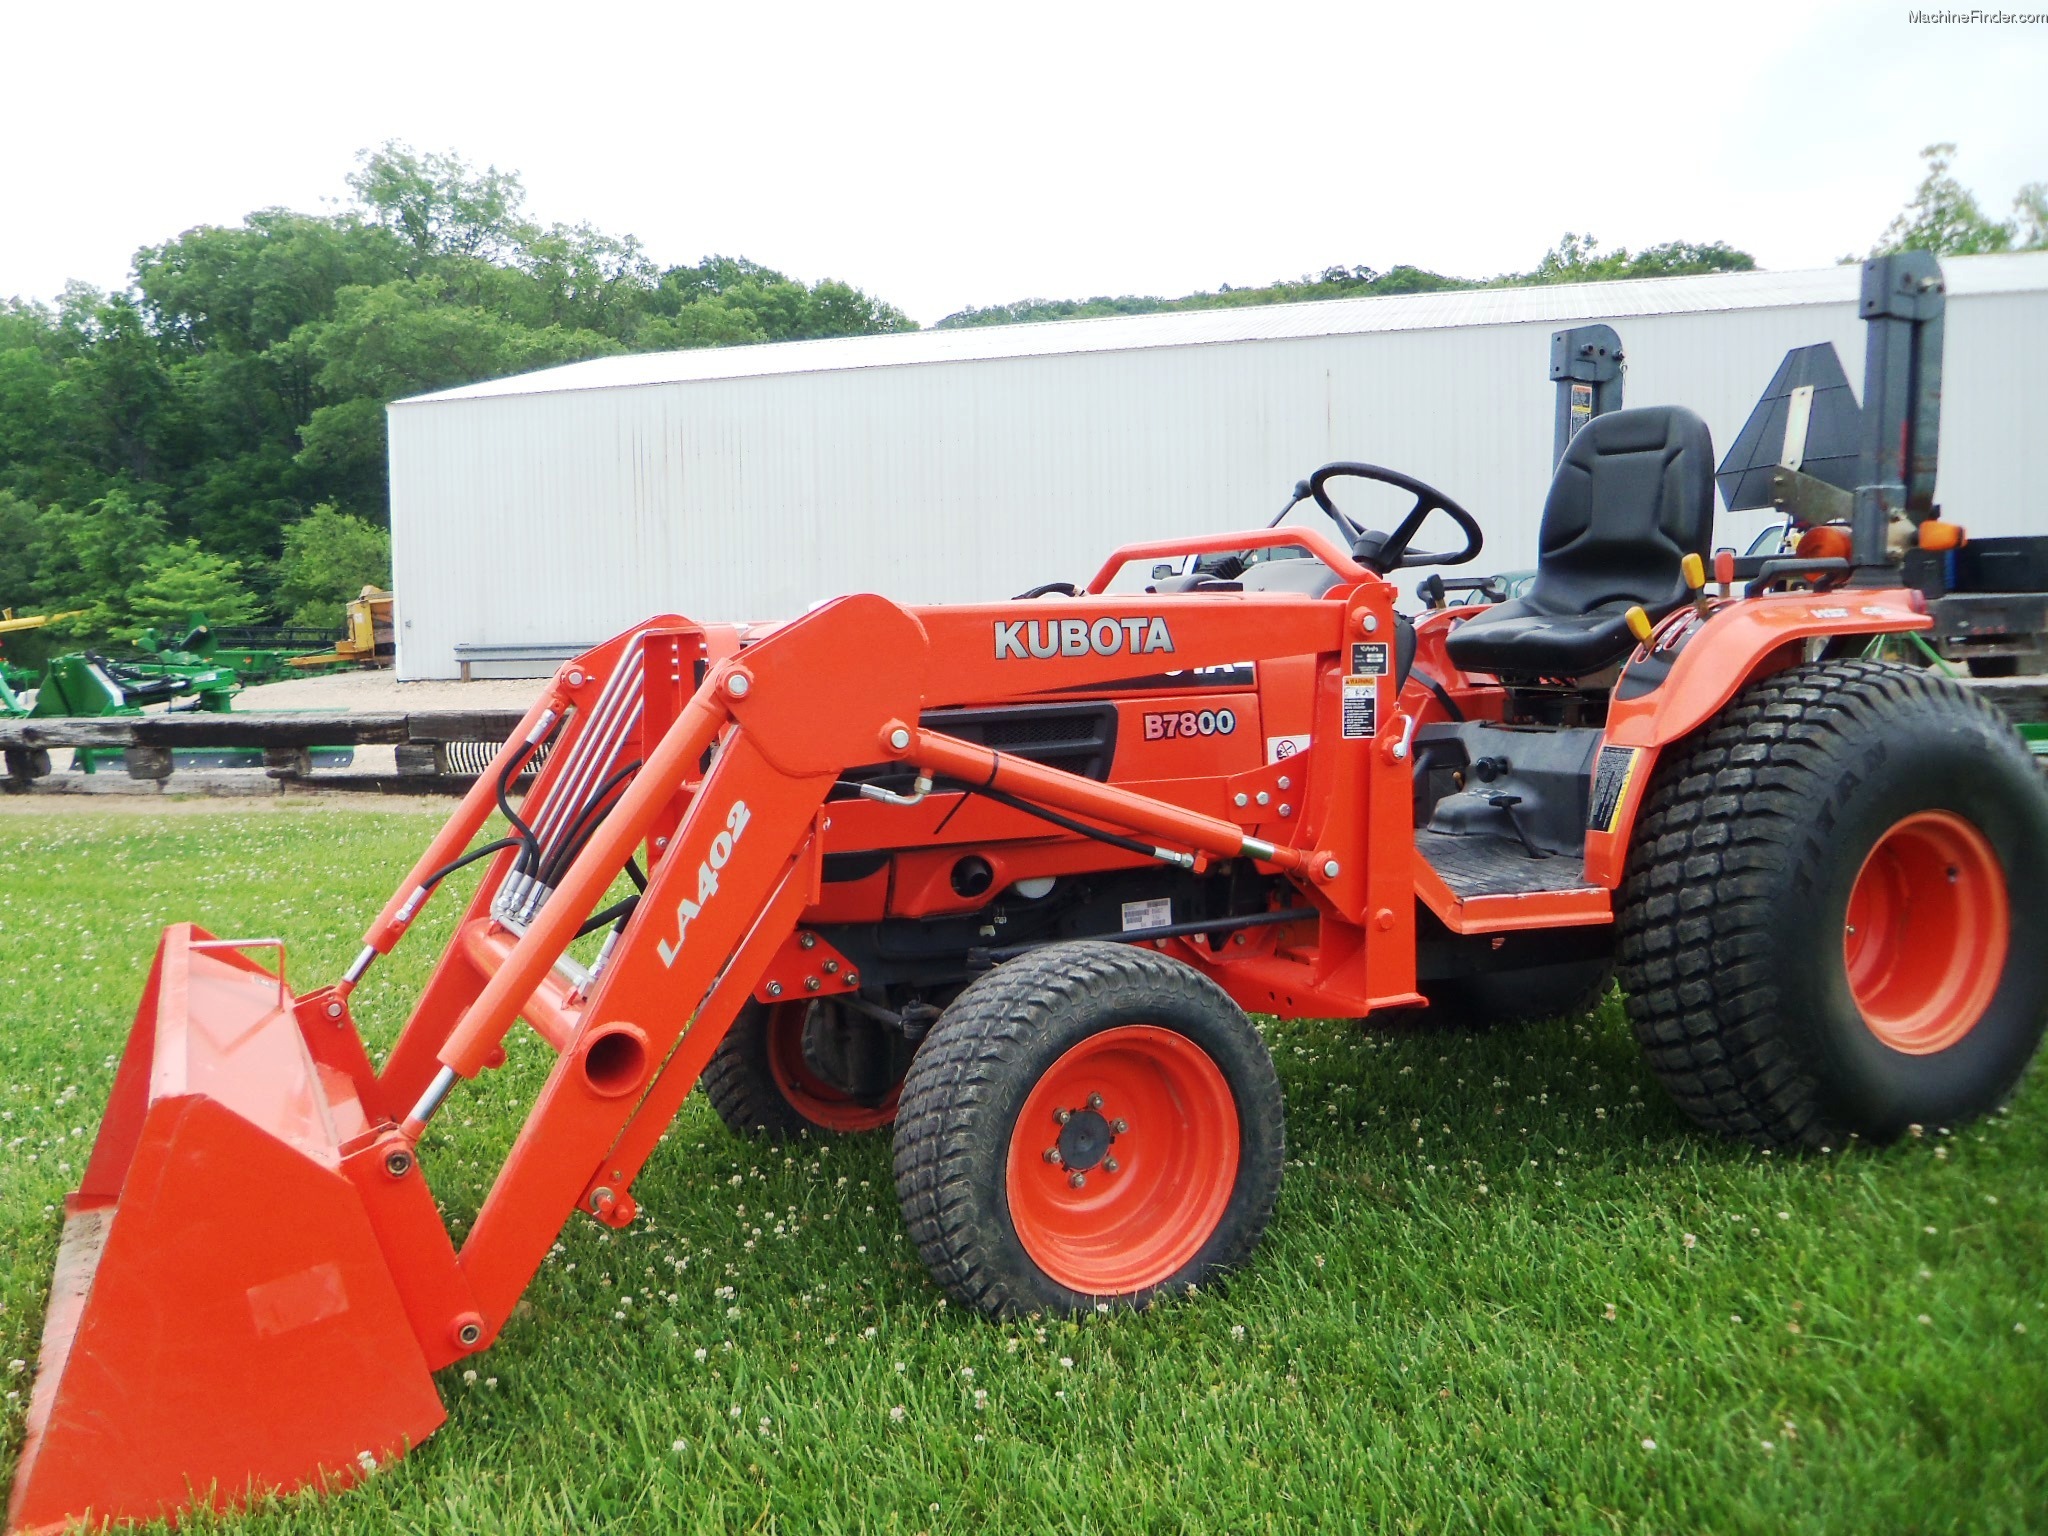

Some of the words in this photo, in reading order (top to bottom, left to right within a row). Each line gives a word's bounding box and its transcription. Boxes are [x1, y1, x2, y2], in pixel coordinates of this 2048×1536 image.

[994, 616, 1175, 660] KUBOTA
[1143, 707, 1236, 741] B7800
[656, 800, 751, 969] LA402
